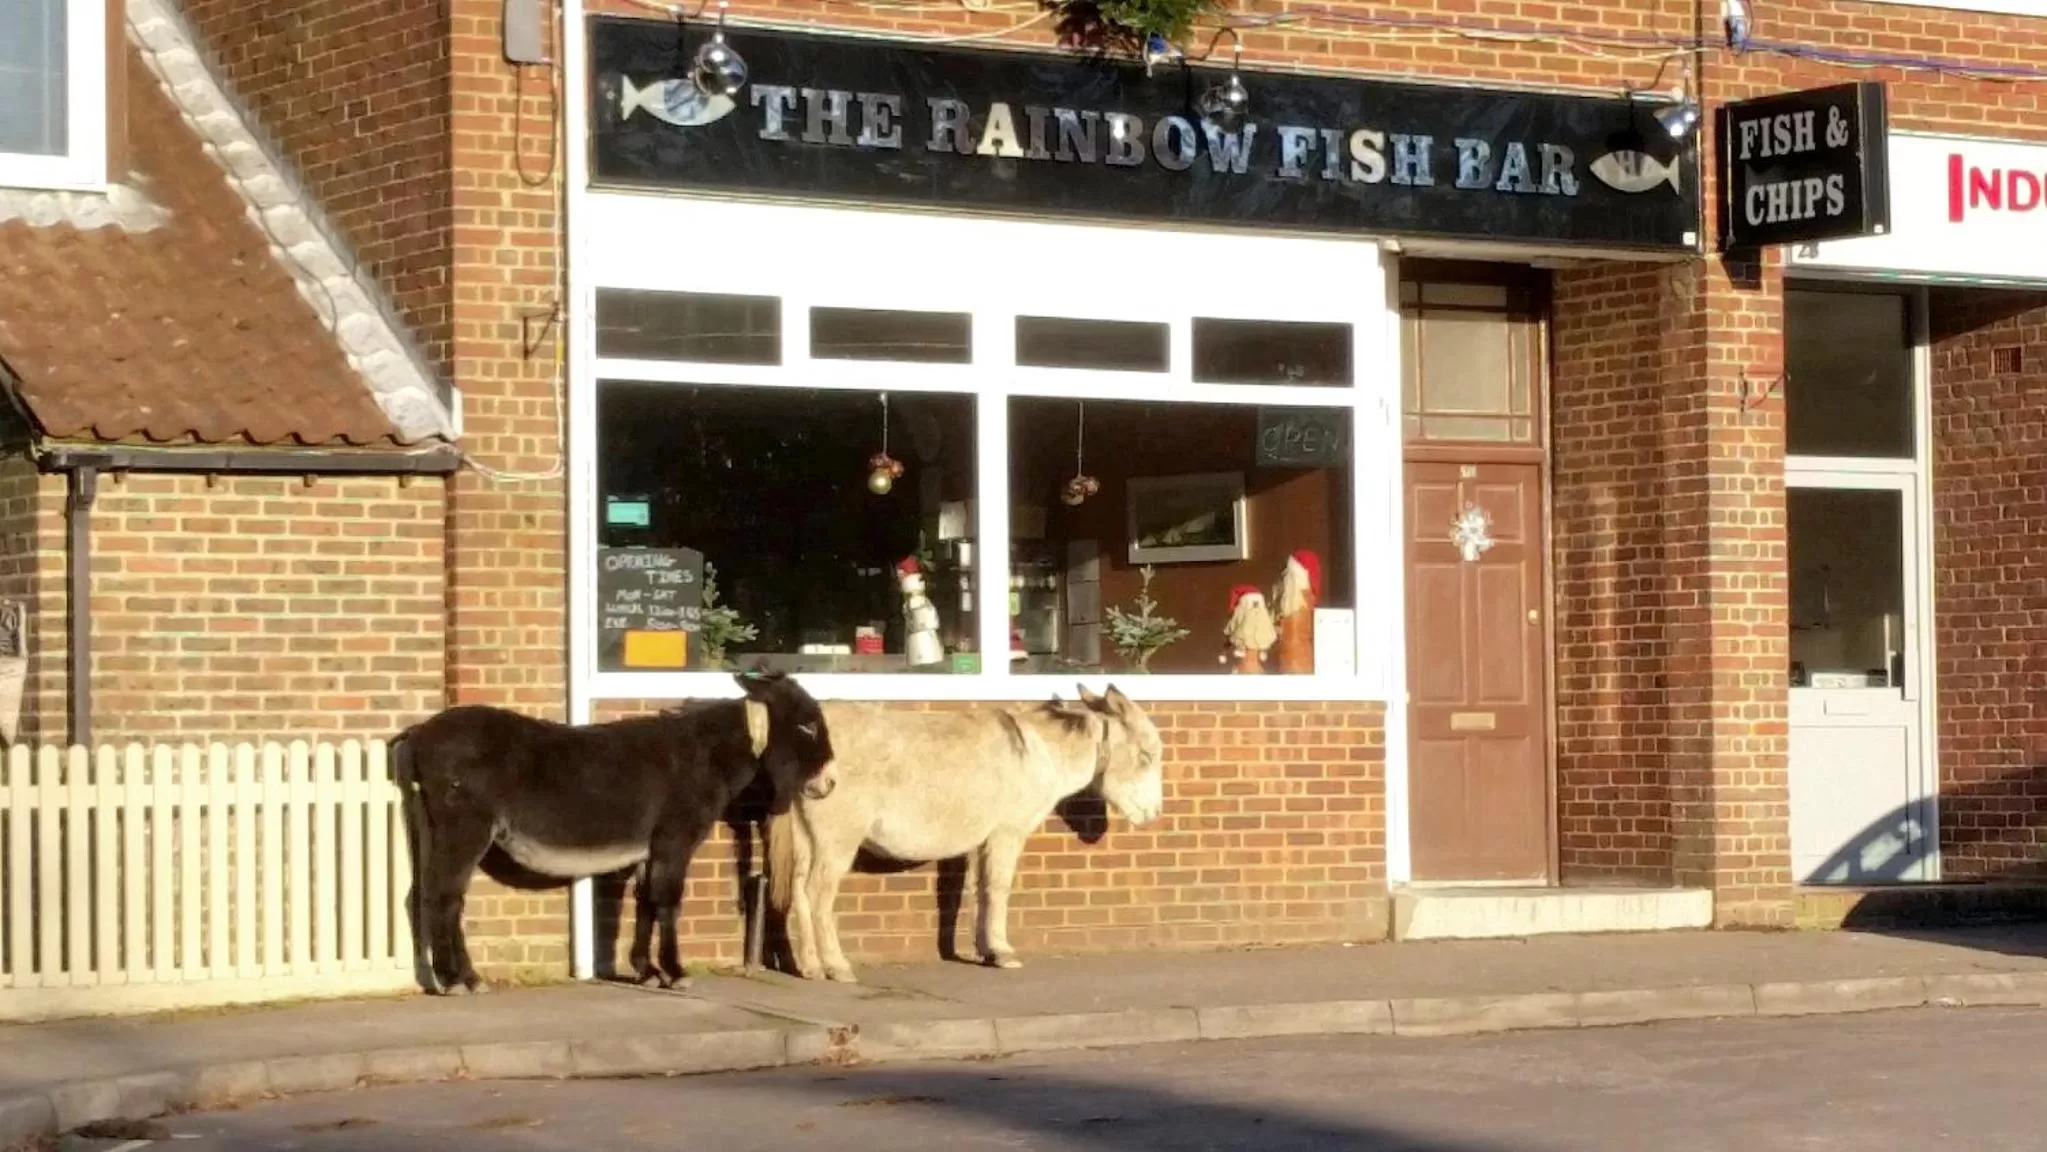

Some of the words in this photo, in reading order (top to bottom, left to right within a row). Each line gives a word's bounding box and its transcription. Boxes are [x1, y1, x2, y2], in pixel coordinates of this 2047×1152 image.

[750, 84, 902, 149] THE
[926, 97, 1257, 175] RAINBOW
[1277, 125, 1435, 187] FISH
[1454, 137, 1580, 197] BAR
[1739, 110, 1816, 160] FISH
[1825, 105, 1849, 149] &
[1745, 174, 1844, 226] CHIPS
[1948, 153, 2047, 222] IND
[645, 569, 694, 584] TIMES
